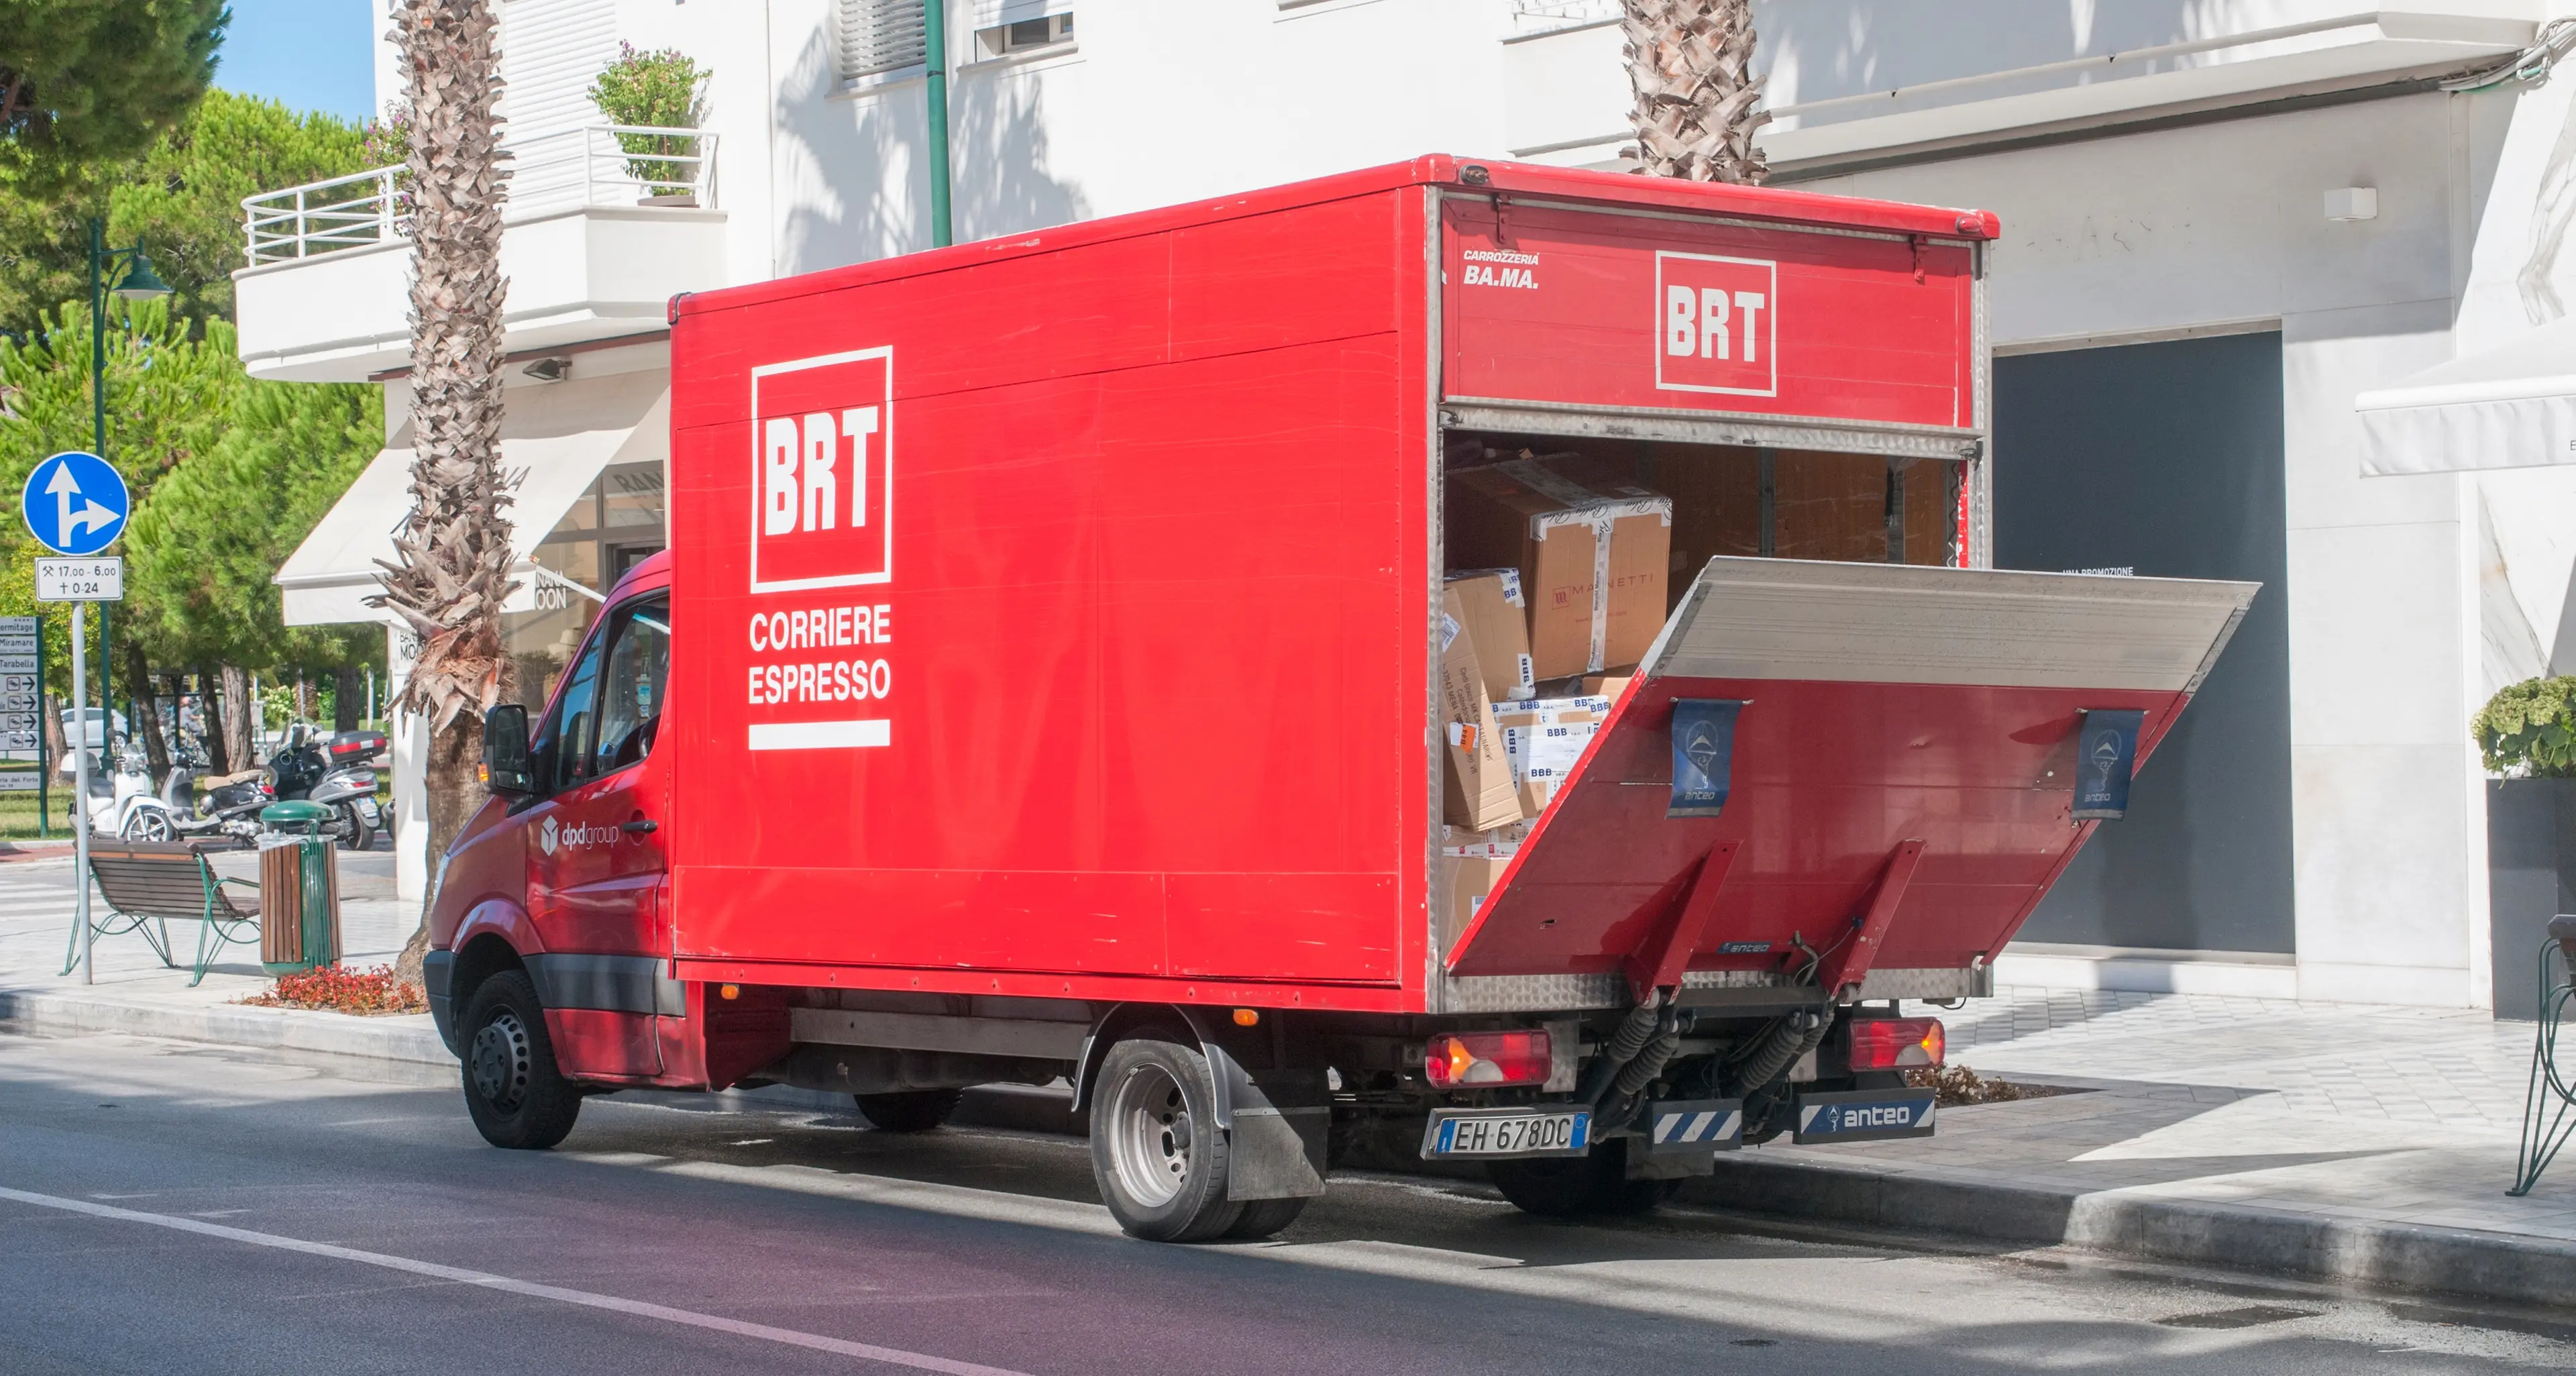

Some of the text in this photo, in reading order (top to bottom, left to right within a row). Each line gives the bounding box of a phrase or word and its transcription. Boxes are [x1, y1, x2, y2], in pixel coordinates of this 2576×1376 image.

[1463, 250, 1539, 265] CARROZZERIA
[1463, 265, 1539, 289] BA.MA.
[1668, 284, 1765, 362] BRT
[765, 405, 878, 536] BRT
[58, 566, 85, 577] 17.00
[94, 566, 116, 576] 6.00
[72, 582, 99, 594] 0-24
[1572, 574, 1654, 595] MANETTI
[536, 588, 567, 610] OON
[0, 623, 34, 632] ermitage
[749, 604, 892, 651] CORRIERE
[400, 644, 423, 660] MOO
[0, 659, 34, 668] Tarabella
[749, 658, 891, 704] ESPRESSO
[1519, 701, 1540, 710] BBB
[1508, 729, 1517, 754] BBB
[1547, 728, 1567, 737] BBB
[1531, 768, 1552, 777] BBB
[1684, 791, 1715, 800] anteo
[2084, 793, 2110, 802] anteo
[562, 821, 619, 851] dpdgroup
[1845, 1106, 1910, 1127] anteo
[1454, 1118, 1570, 1151] EH 678DC
